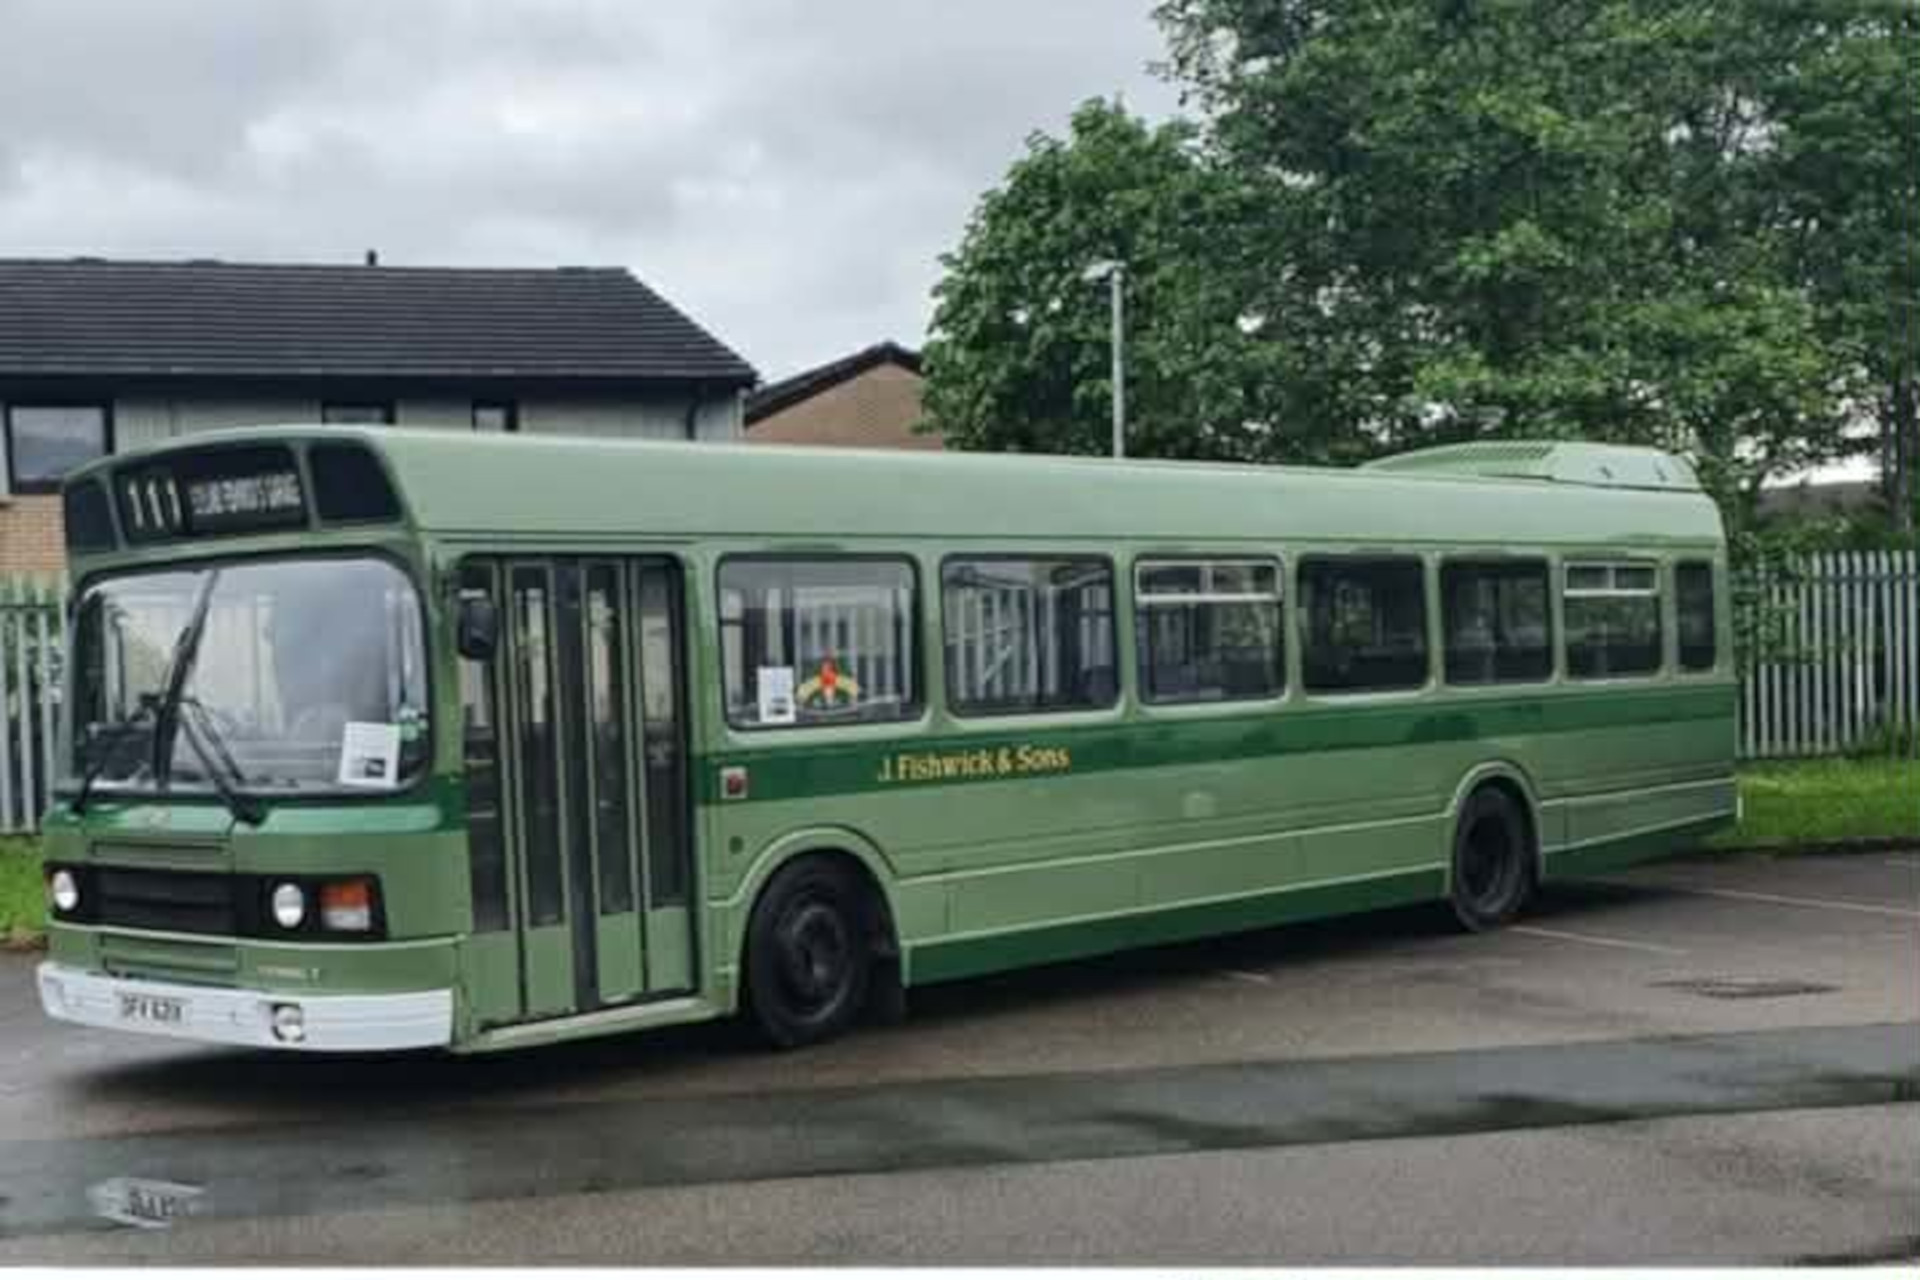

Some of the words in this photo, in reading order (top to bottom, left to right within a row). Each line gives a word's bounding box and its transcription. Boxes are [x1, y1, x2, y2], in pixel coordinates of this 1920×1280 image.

[127, 477, 182, 528] 111
[898, 749, 995, 781] Fishwick
[998, 748, 1014, 774] &
[1017, 745, 1070, 771] Sons
